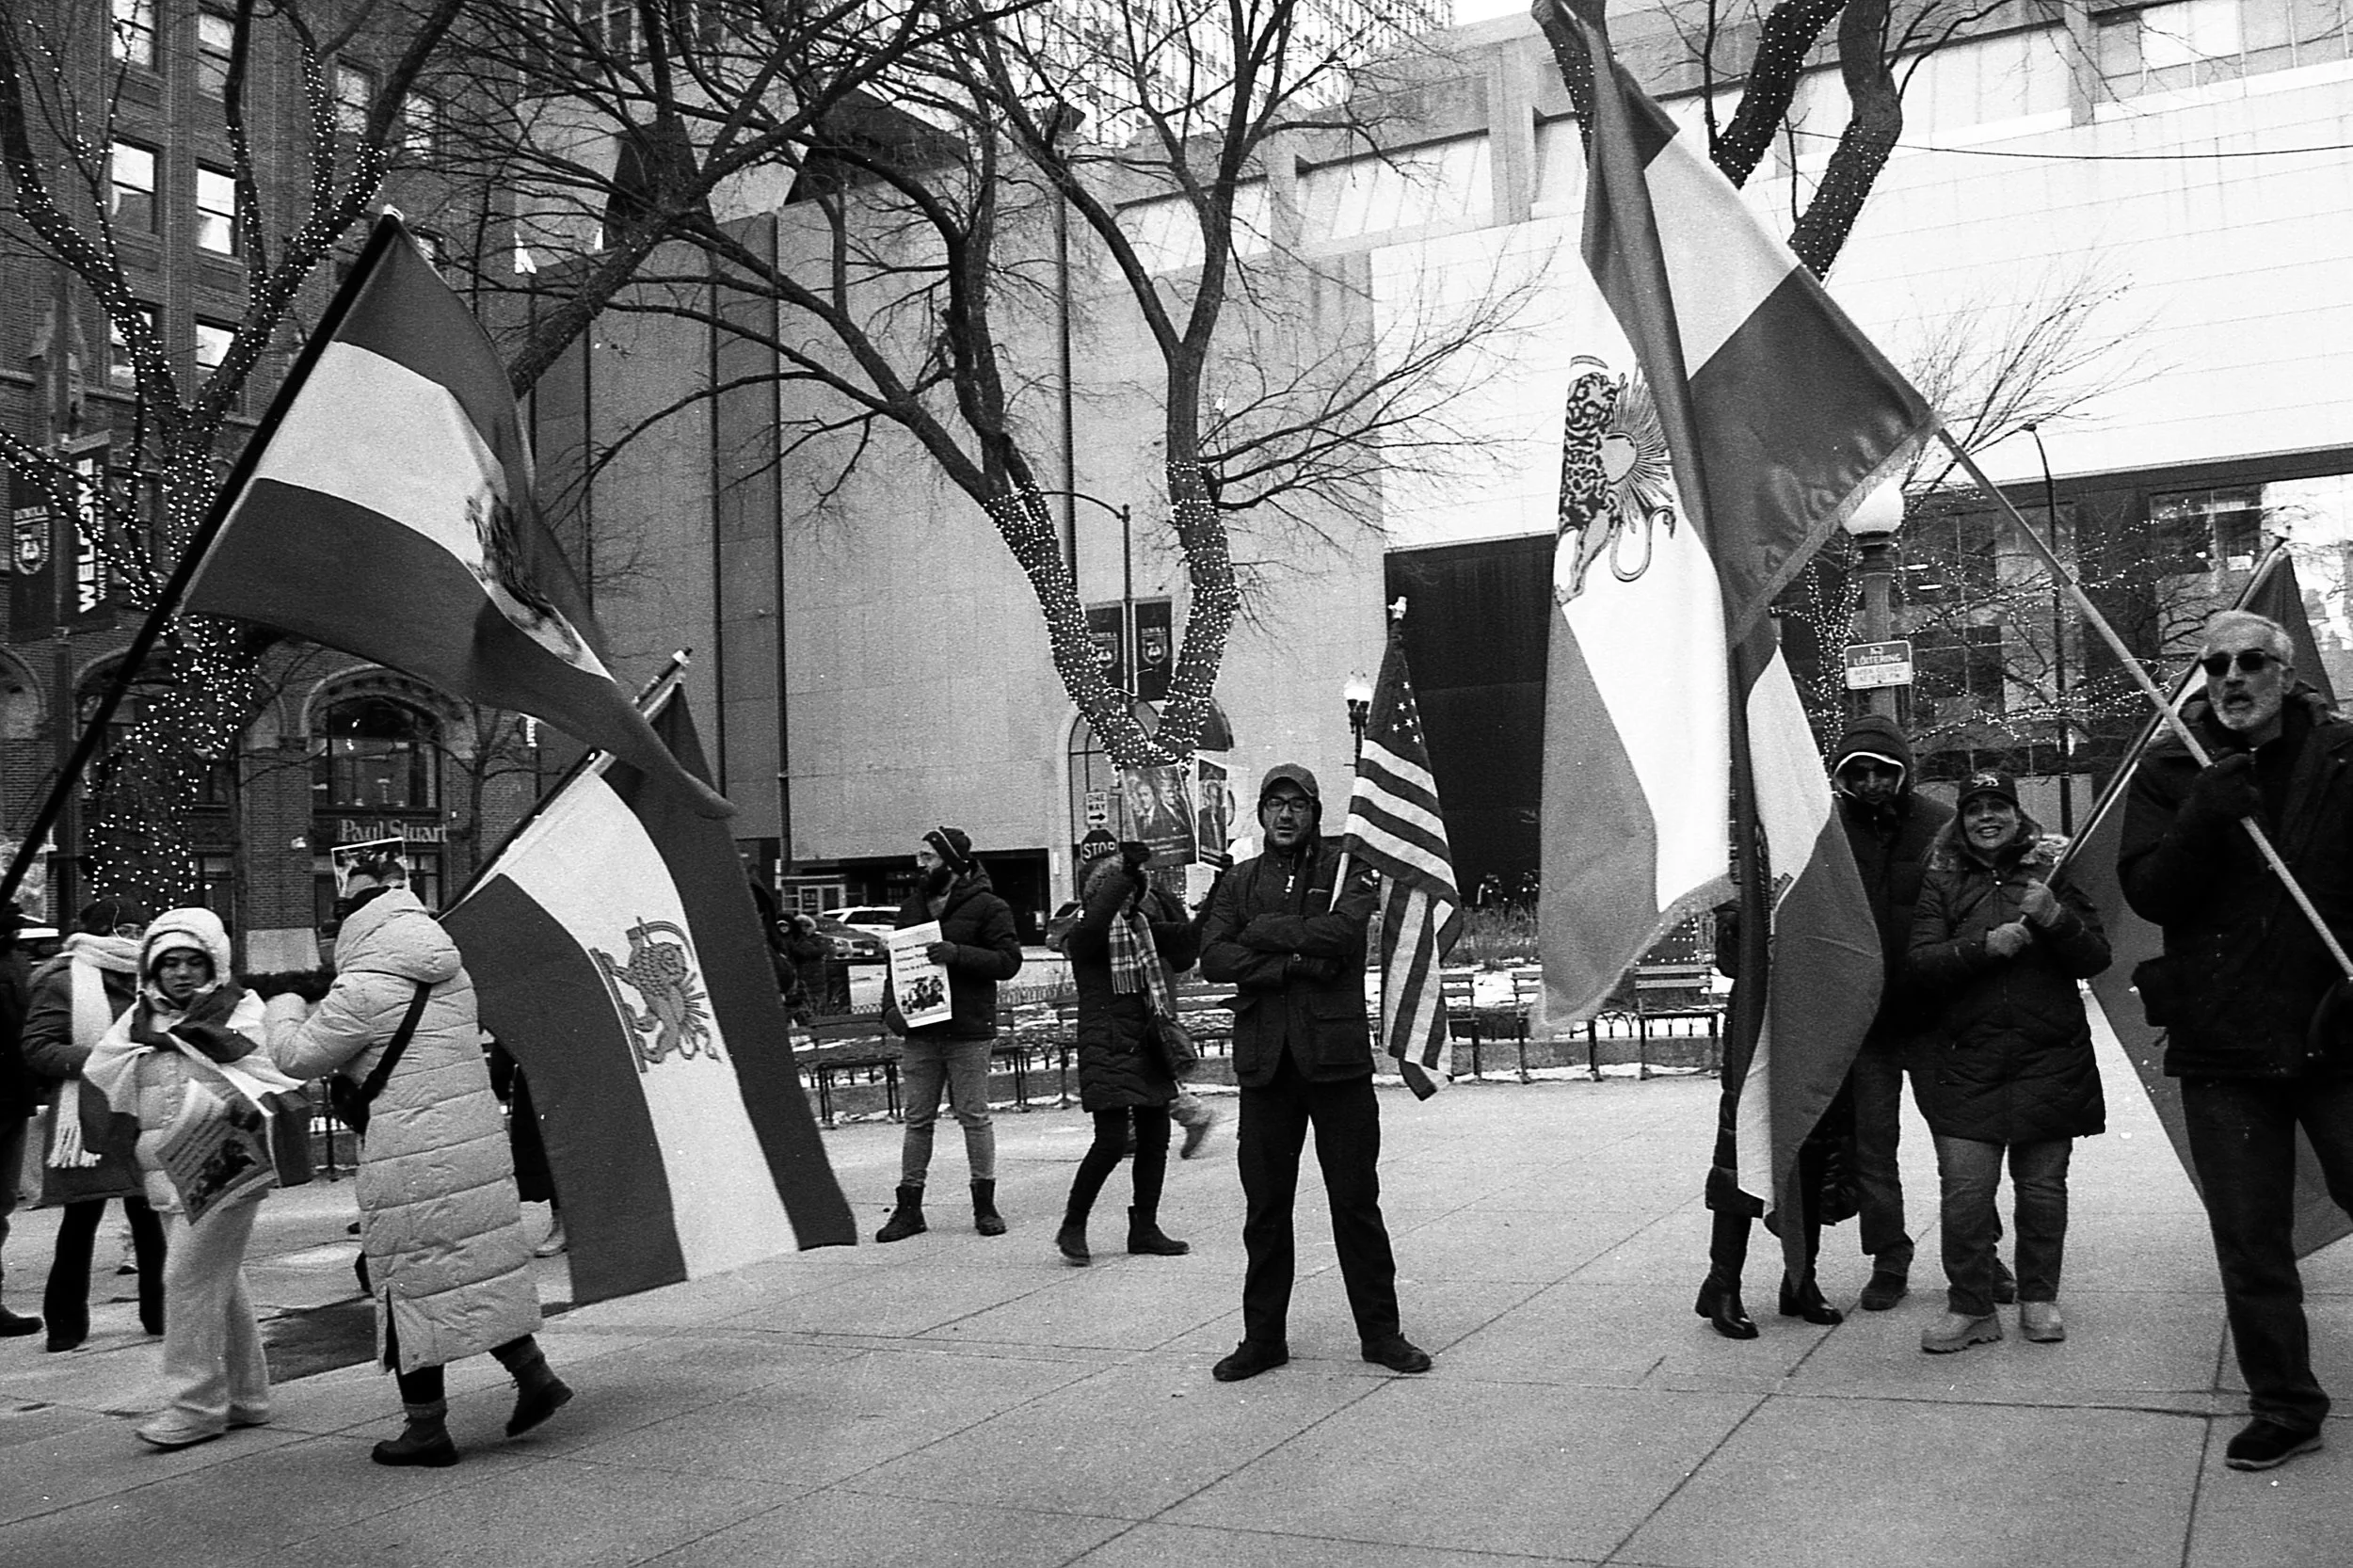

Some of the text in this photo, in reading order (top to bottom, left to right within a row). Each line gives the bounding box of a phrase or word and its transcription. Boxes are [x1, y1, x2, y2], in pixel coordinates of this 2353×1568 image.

[1088, 793, 1105, 802] ONE
[340, 819, 449, 843] Paul Stuart
[1083, 841, 1116, 859] STOP
